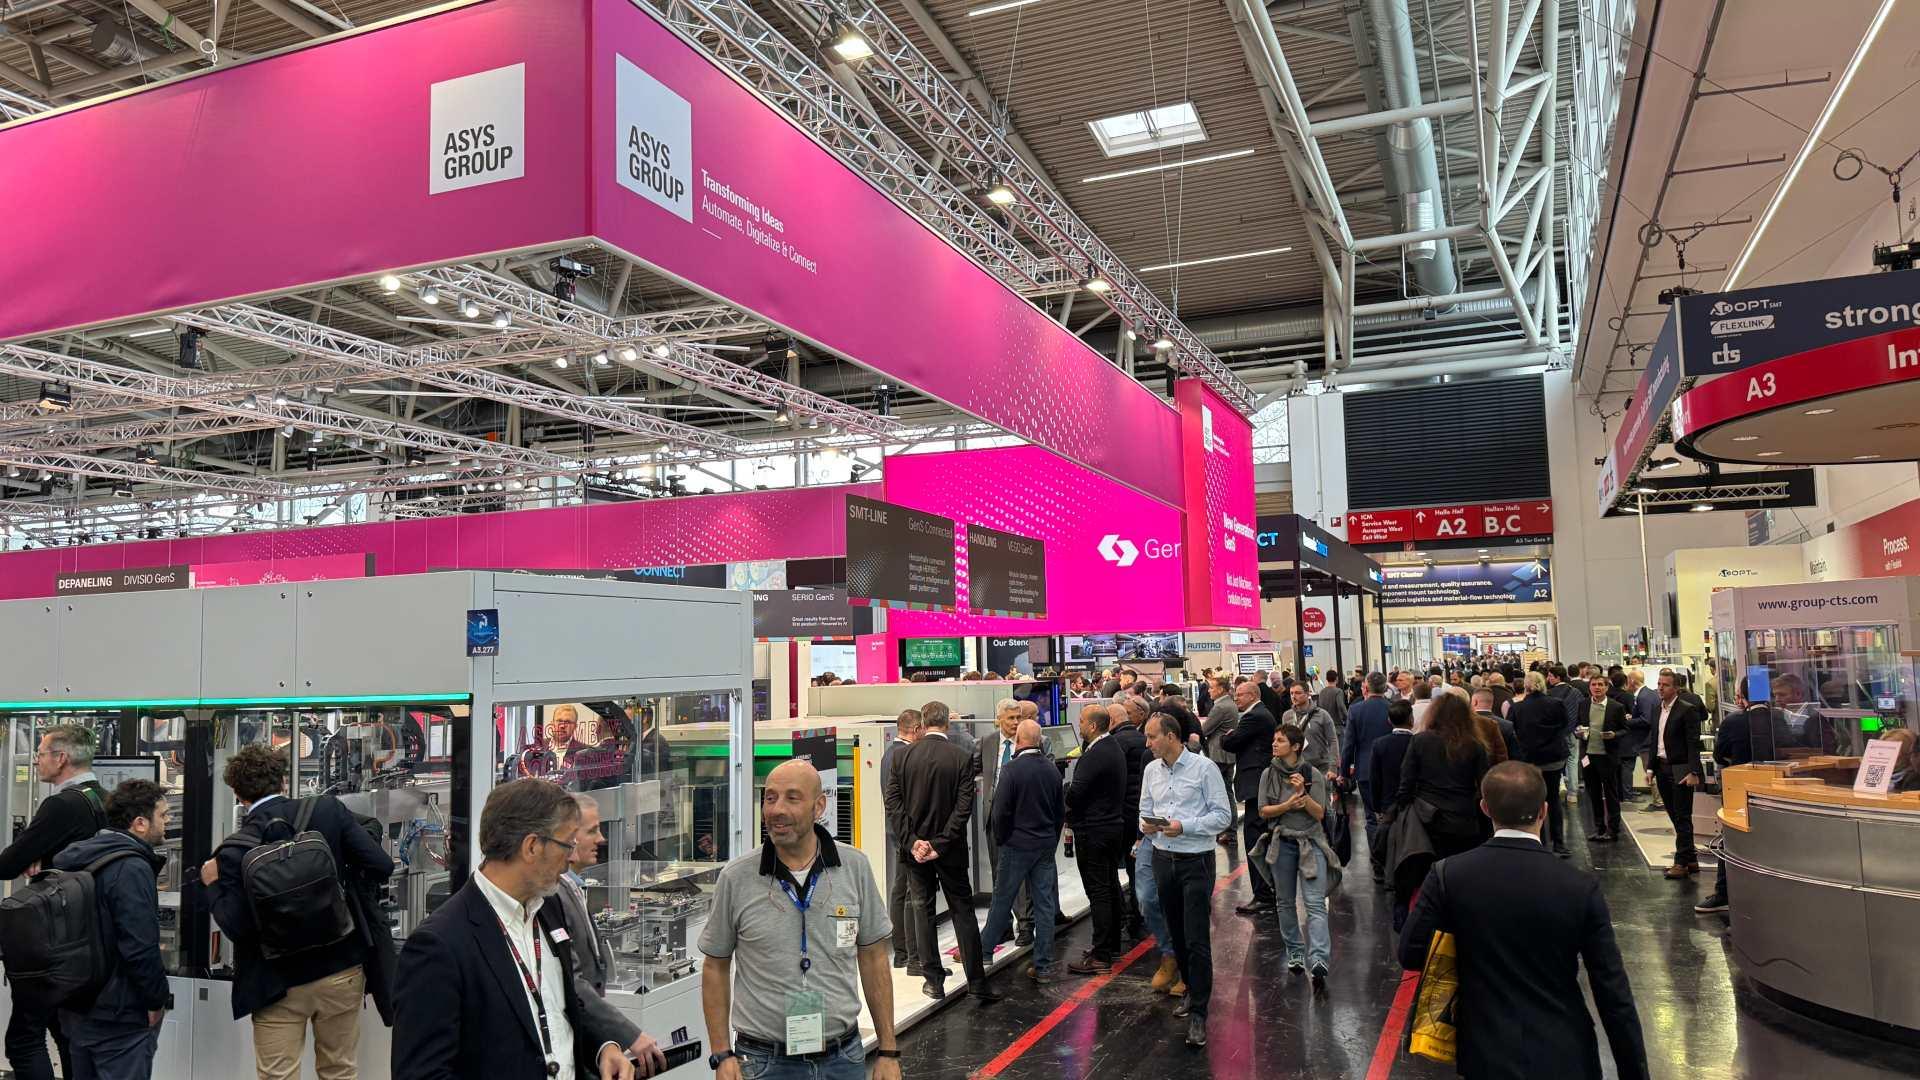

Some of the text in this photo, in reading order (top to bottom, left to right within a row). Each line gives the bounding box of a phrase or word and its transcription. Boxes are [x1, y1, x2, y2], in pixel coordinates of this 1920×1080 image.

[443, 124, 495, 155] ASYS
[628, 125, 670, 169] ASYS
[444, 146, 513, 179] GROUP
[629, 153, 684, 202] GROUP
[701, 168, 784, 233] Transforming Ideas
[702, 194, 817, 274] Automate, Digitalize & Connect
[1720, 320, 1765, 331] FLEXLINK
[1746, 372, 1777, 402] A3
[849, 504, 888, 525] SMT-LINE
[908, 518, 925, 533] GenS
[1436, 518, 1467, 536] A2
[1485, 514, 1521, 536] B,C
[969, 531, 997, 548] HANDLING
[1883, 536, 1910, 556] Process.
[58, 572, 175, 589] DEPANELING DIVISIO GenS
[634, 565, 686, 578] CONNECT
[1440, 580, 1460, 588] quality
[791, 593, 814, 601] SERIO
[1533, 589, 1548, 598] A2
[1758, 594, 1878, 612] www.group-cts.com
[472, 646, 495, 654] A3.277
[993, 639, 1007, 647] Our
